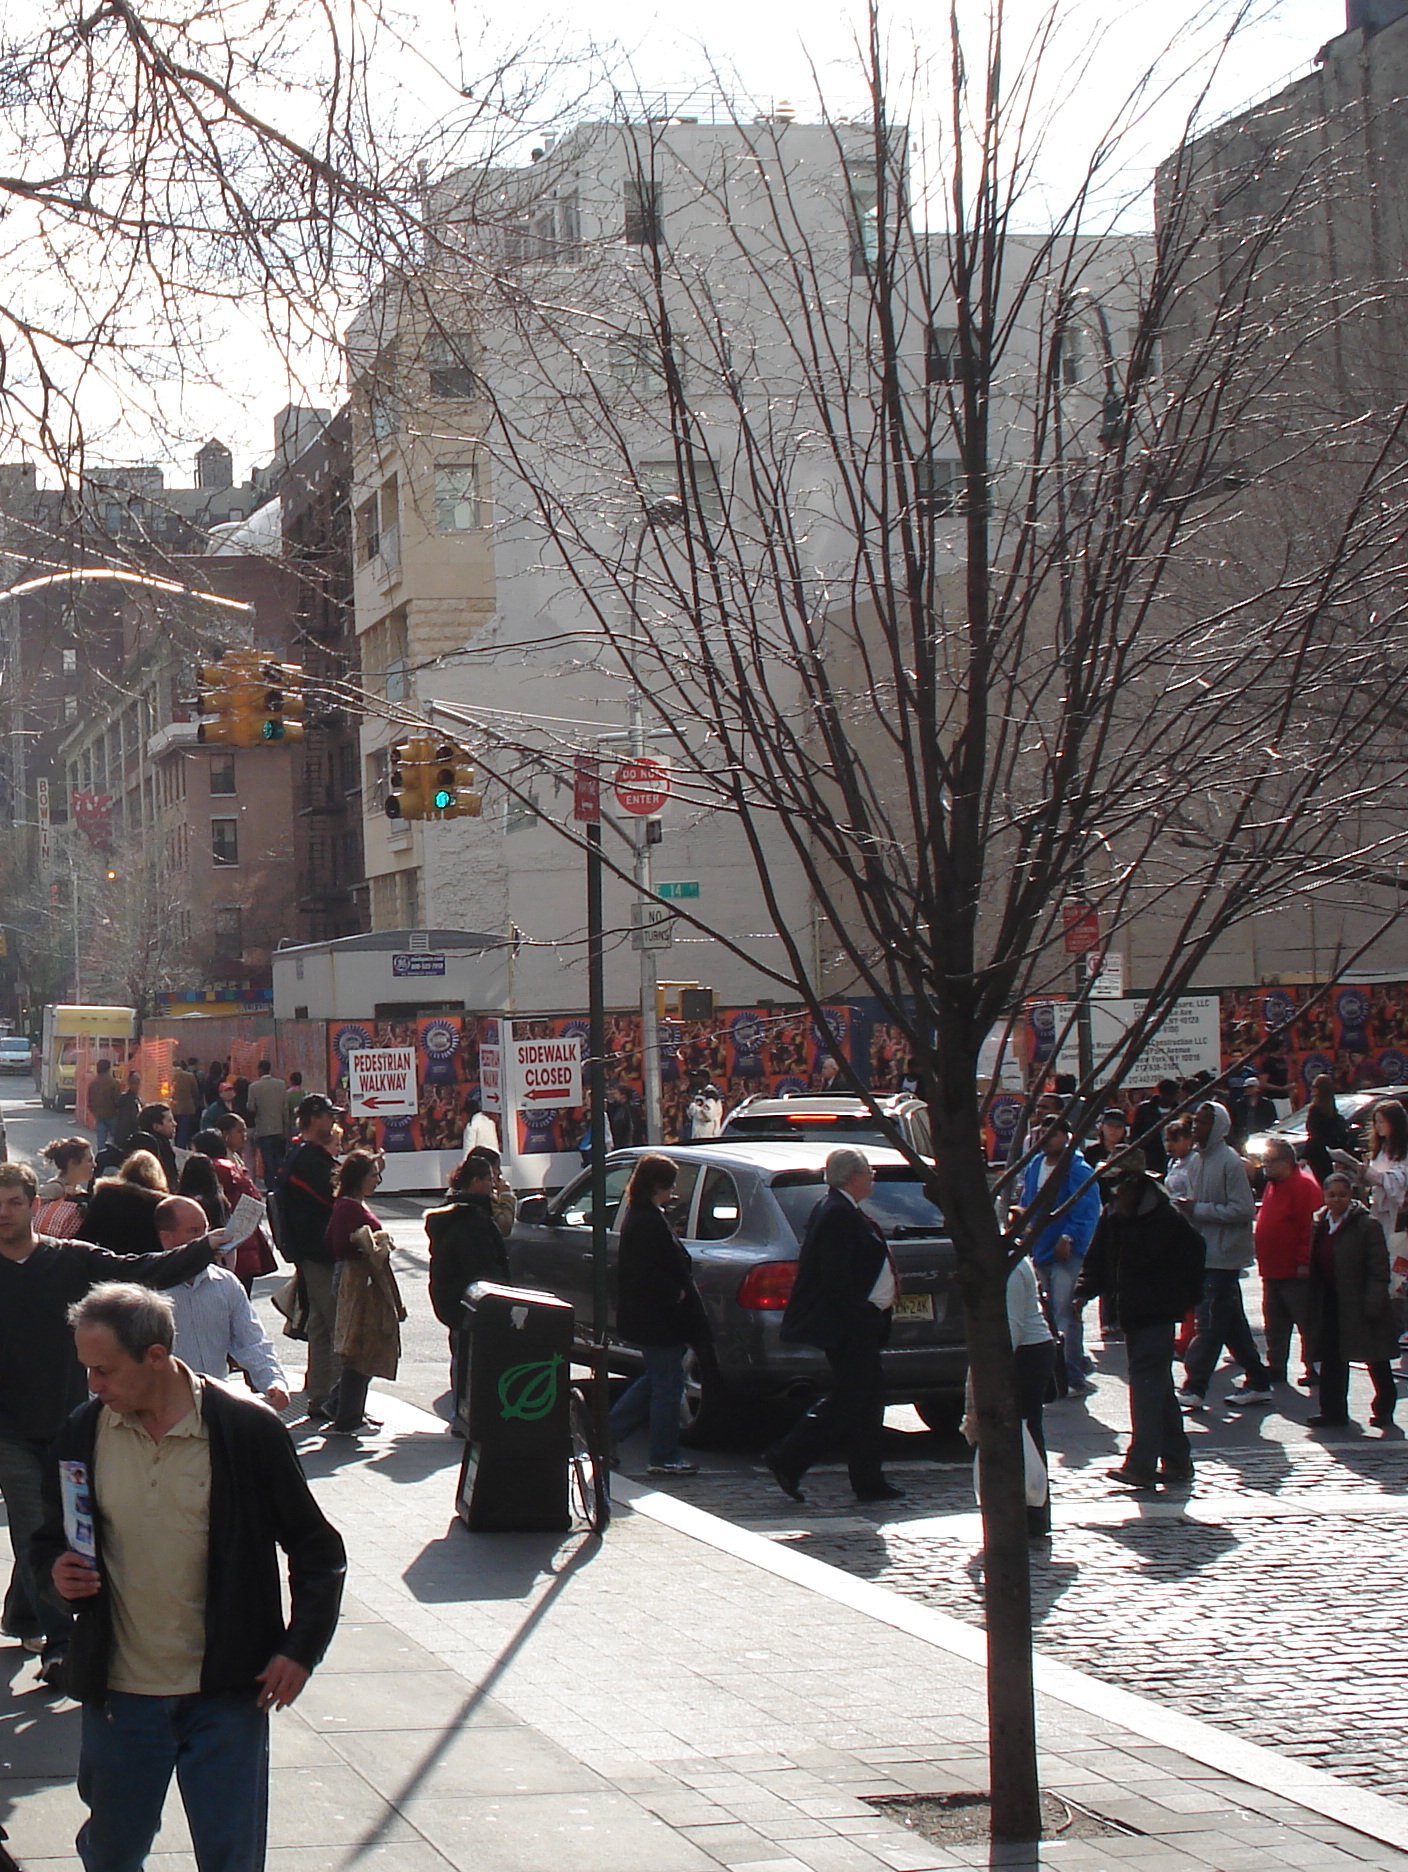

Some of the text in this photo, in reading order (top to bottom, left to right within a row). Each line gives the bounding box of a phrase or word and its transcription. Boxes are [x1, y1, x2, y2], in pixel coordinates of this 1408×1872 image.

[626, 794, 659, 805] ENTER
[38, 780, 50, 871] BOWLING
[670, 884, 682, 898] 14
[648, 910, 662, 923] NO
[353, 1052, 411, 1073] PEDESTRIAN
[518, 1043, 576, 1065] SIDEWALK
[359, 1072, 407, 1092] WALKWAY
[525, 1067, 572, 1087] CLOSED
